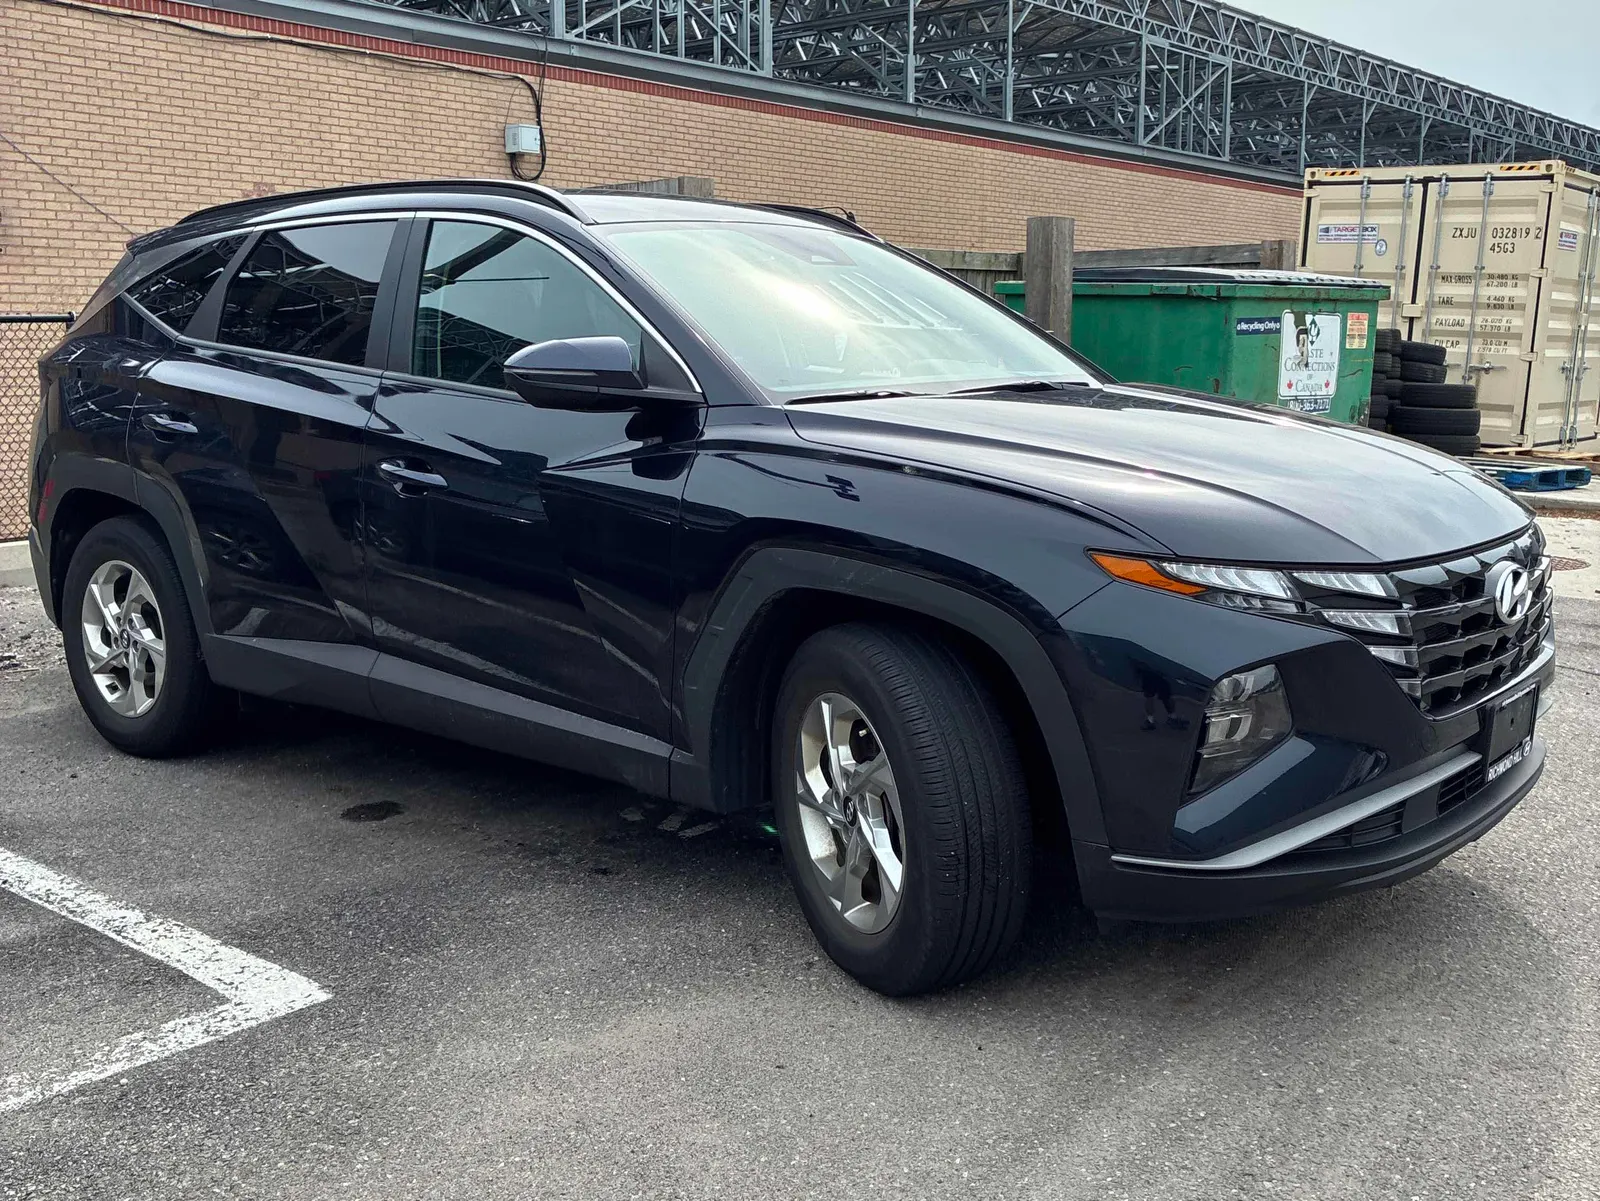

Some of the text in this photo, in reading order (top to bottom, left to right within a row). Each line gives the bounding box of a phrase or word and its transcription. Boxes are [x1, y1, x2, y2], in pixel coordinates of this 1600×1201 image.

[1452, 227, 1542, 239] ZXJU 032819 2
[1490, 242, 1515, 254] 45G3
[1438, 296, 1454, 305] TARE
[1240, 320, 1276, 331] Recycling Only
[1434, 318, 1465, 327] PAYLOAD
[1488, 747, 1523, 782] RICHMOND HILL
